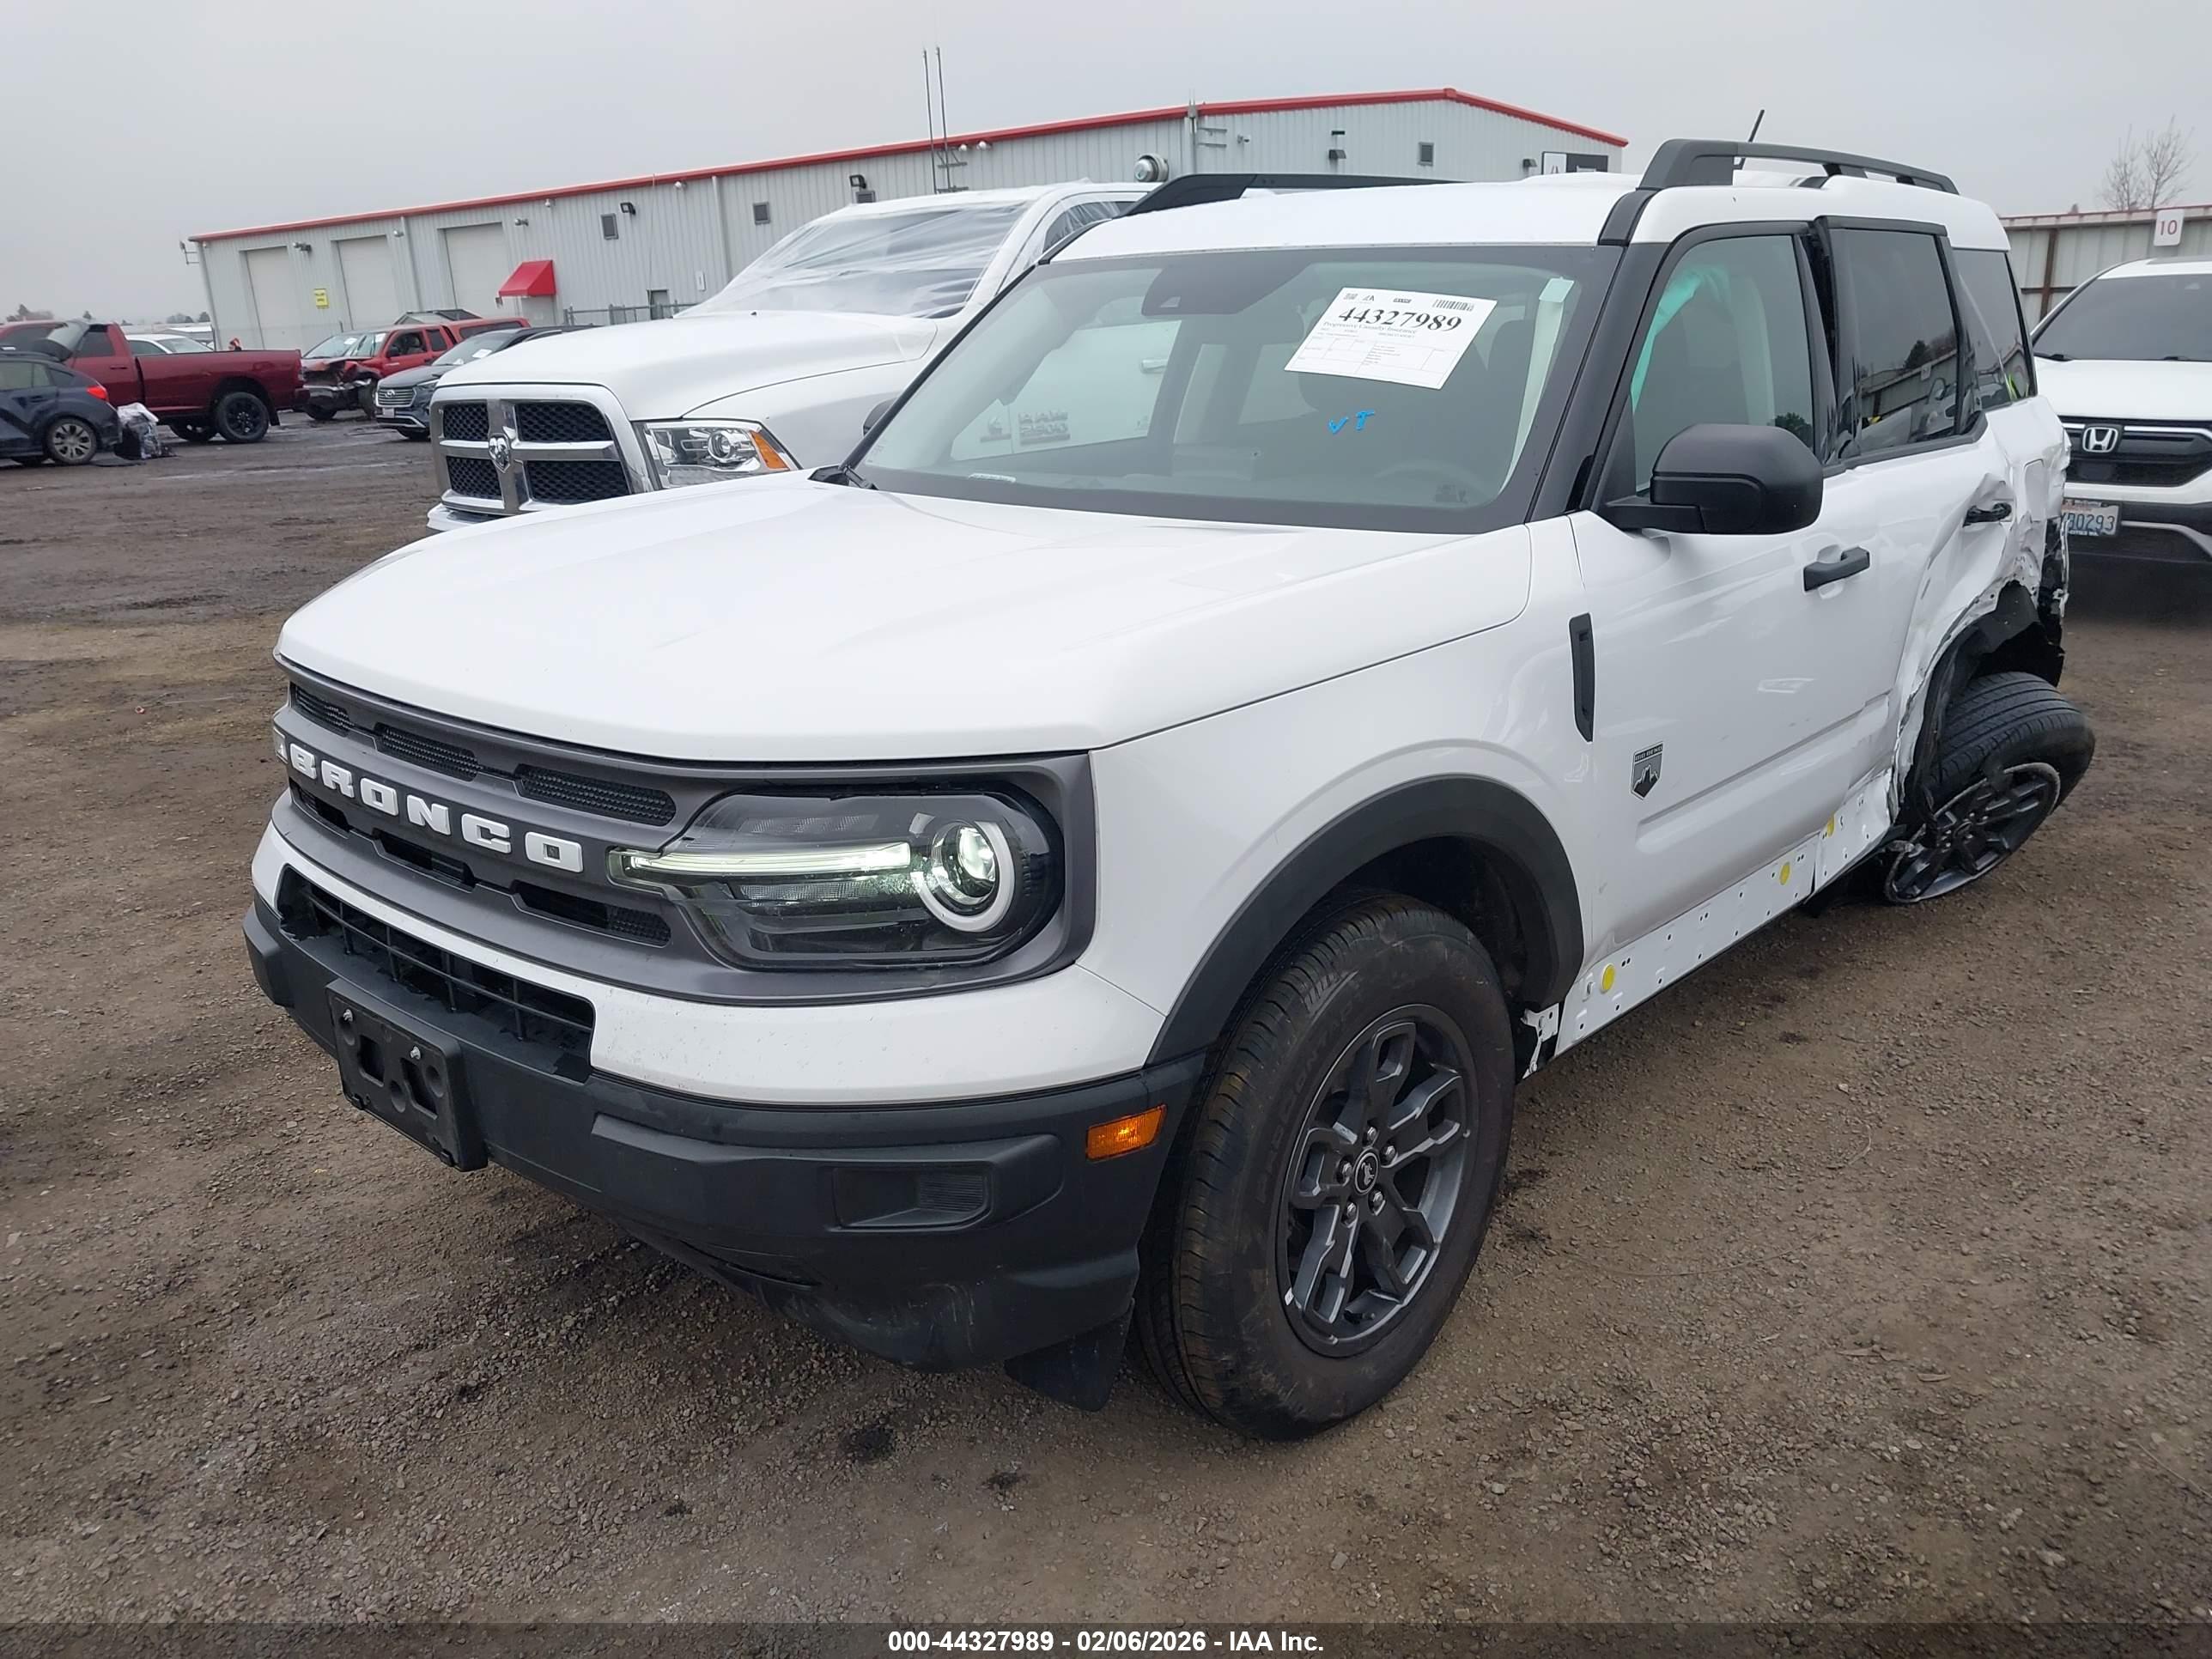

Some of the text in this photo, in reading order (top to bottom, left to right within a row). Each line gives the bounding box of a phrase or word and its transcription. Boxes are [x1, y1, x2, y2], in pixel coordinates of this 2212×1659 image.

[2160, 220, 2178, 236] 10
[1338, 307, 1463, 332] 44327989
[289, 742, 584, 874] BRONCO
